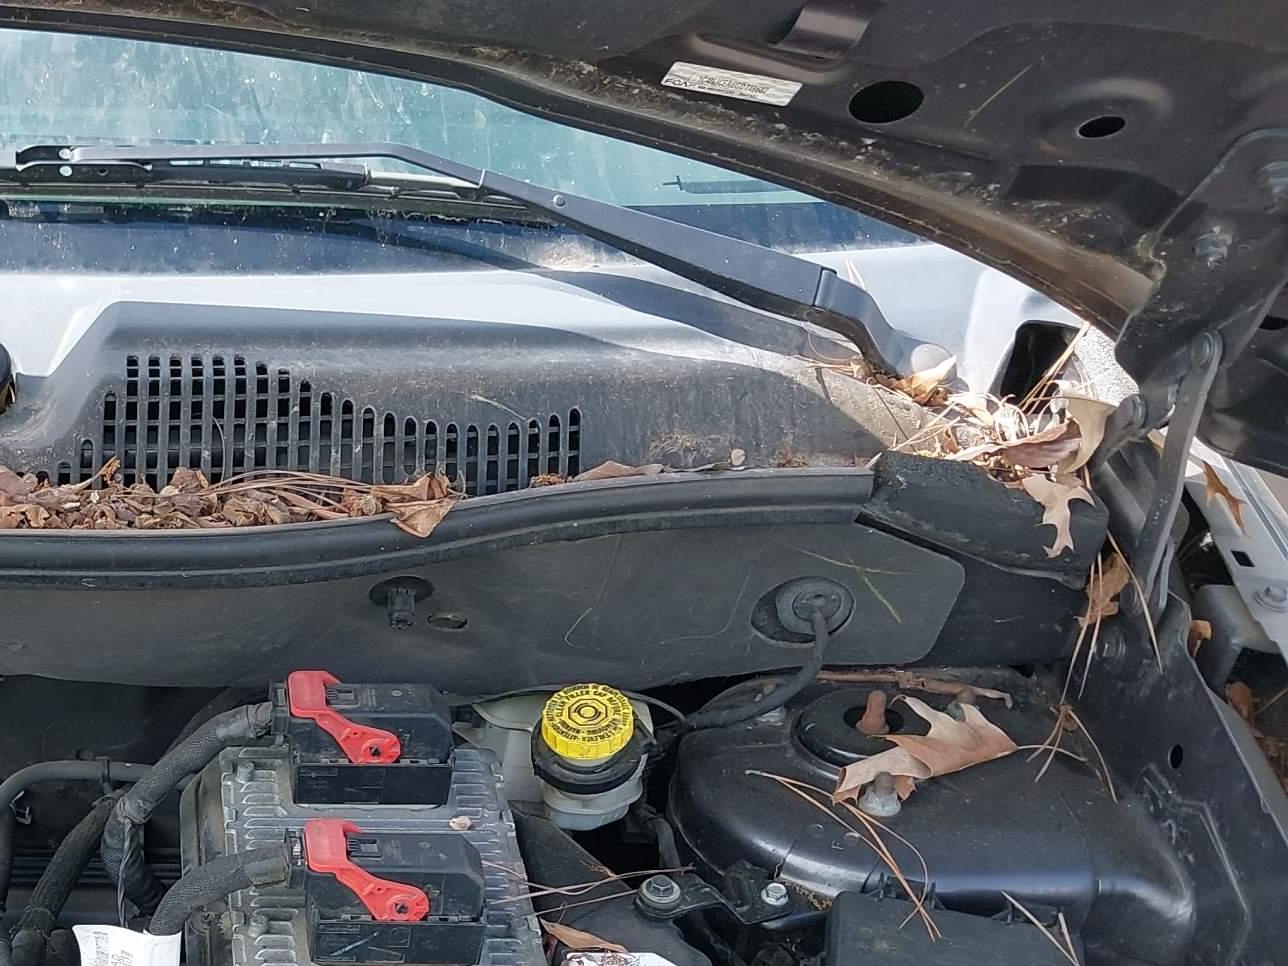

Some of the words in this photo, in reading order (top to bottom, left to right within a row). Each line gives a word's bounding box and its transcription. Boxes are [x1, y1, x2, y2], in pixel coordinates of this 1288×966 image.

[555, 700, 566, 717] CLEAN
[565, 690, 590, 701] FILLER
[606, 696, 621, 717] BEFORE
